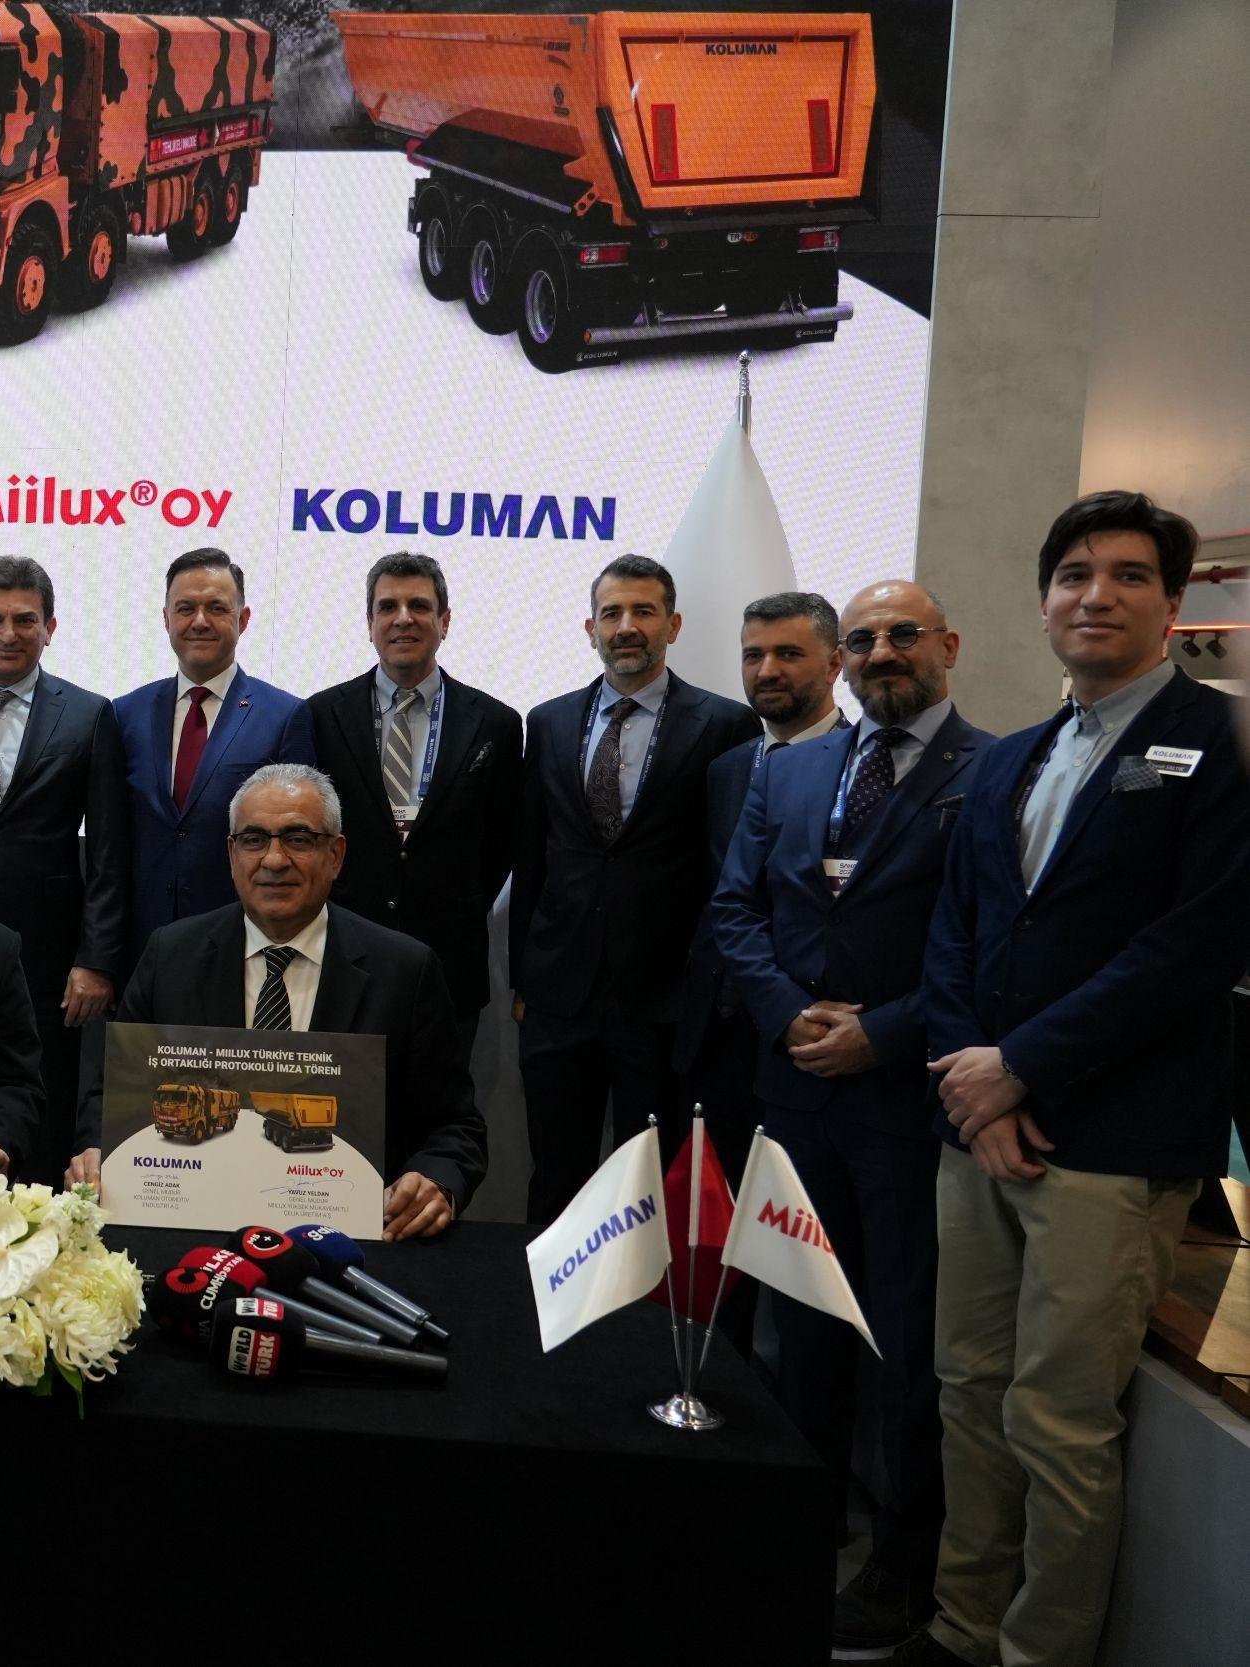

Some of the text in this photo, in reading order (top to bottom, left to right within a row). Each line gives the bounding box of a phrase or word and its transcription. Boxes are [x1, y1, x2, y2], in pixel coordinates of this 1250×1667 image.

[705, 43, 777, 55] KOLUMAN
[292, 488, 617, 541] KOLUMAN
[1153, 750, 1193, 759] KOLUMAN
[157, 1045, 207, 1056] KOLUMAN
[215, 1048, 250, 1058] MIILUX
[252, 1049, 295, 1061] TÜRKİYE
[296, 1052, 333, 1062] TEKNİK
[148, 1056, 341, 1075] İŞ ORTAKLIĞI PROTOKOLÜ İMZA TÖRENİ
[133, 1156, 202, 1170] KOLUMAN
[549, 1193, 656, 1293] KOLUMAN
[255, 1334, 276, 1377] TÜRK
